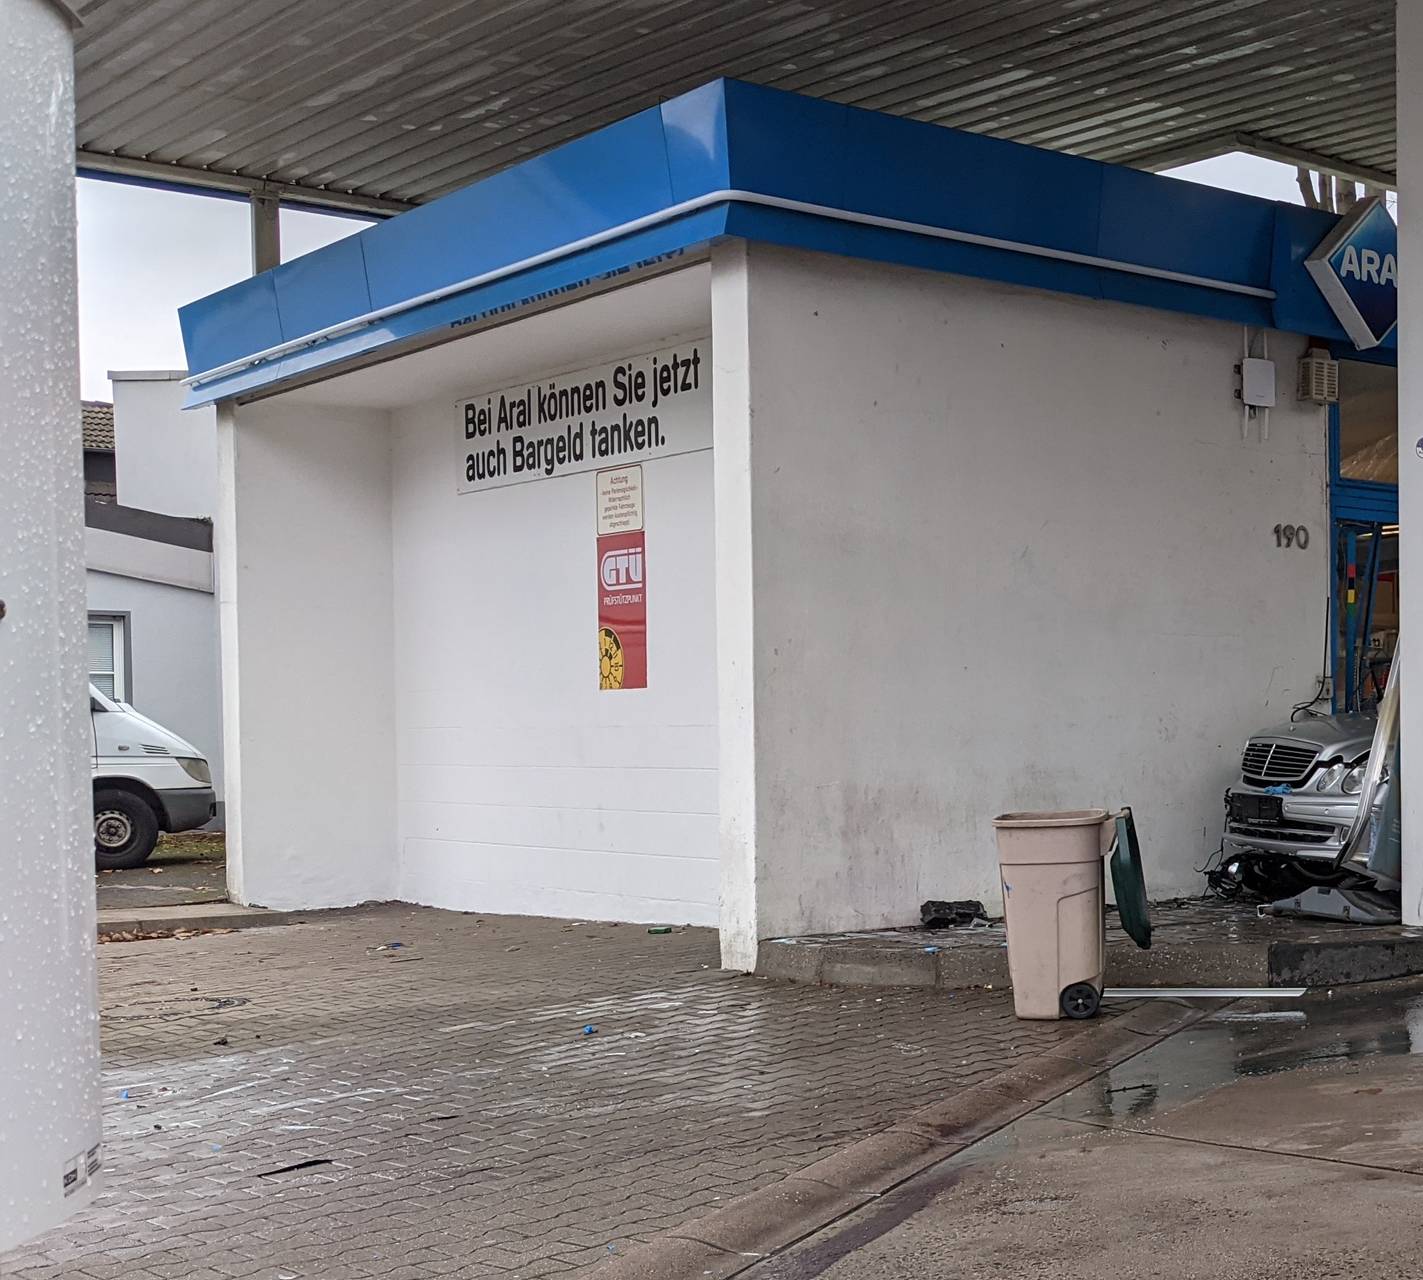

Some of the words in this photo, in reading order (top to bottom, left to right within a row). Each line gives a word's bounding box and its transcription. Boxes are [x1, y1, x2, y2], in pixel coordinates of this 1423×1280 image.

[1340, 246, 1397, 288] ARA
[464, 398, 492, 440] Bei
[497, 388, 531, 433] Aral
[537, 382, 606, 424] können
[613, 363, 646, 407] Sie
[652, 348, 700, 408] jetzt
[466, 440, 506, 482] auch
[512, 422, 584, 476] Bargeld
[590, 412, 666, 459] tanken.
[1273, 523, 1309, 550] 190
[602, 548, 642, 586] GTÜ
